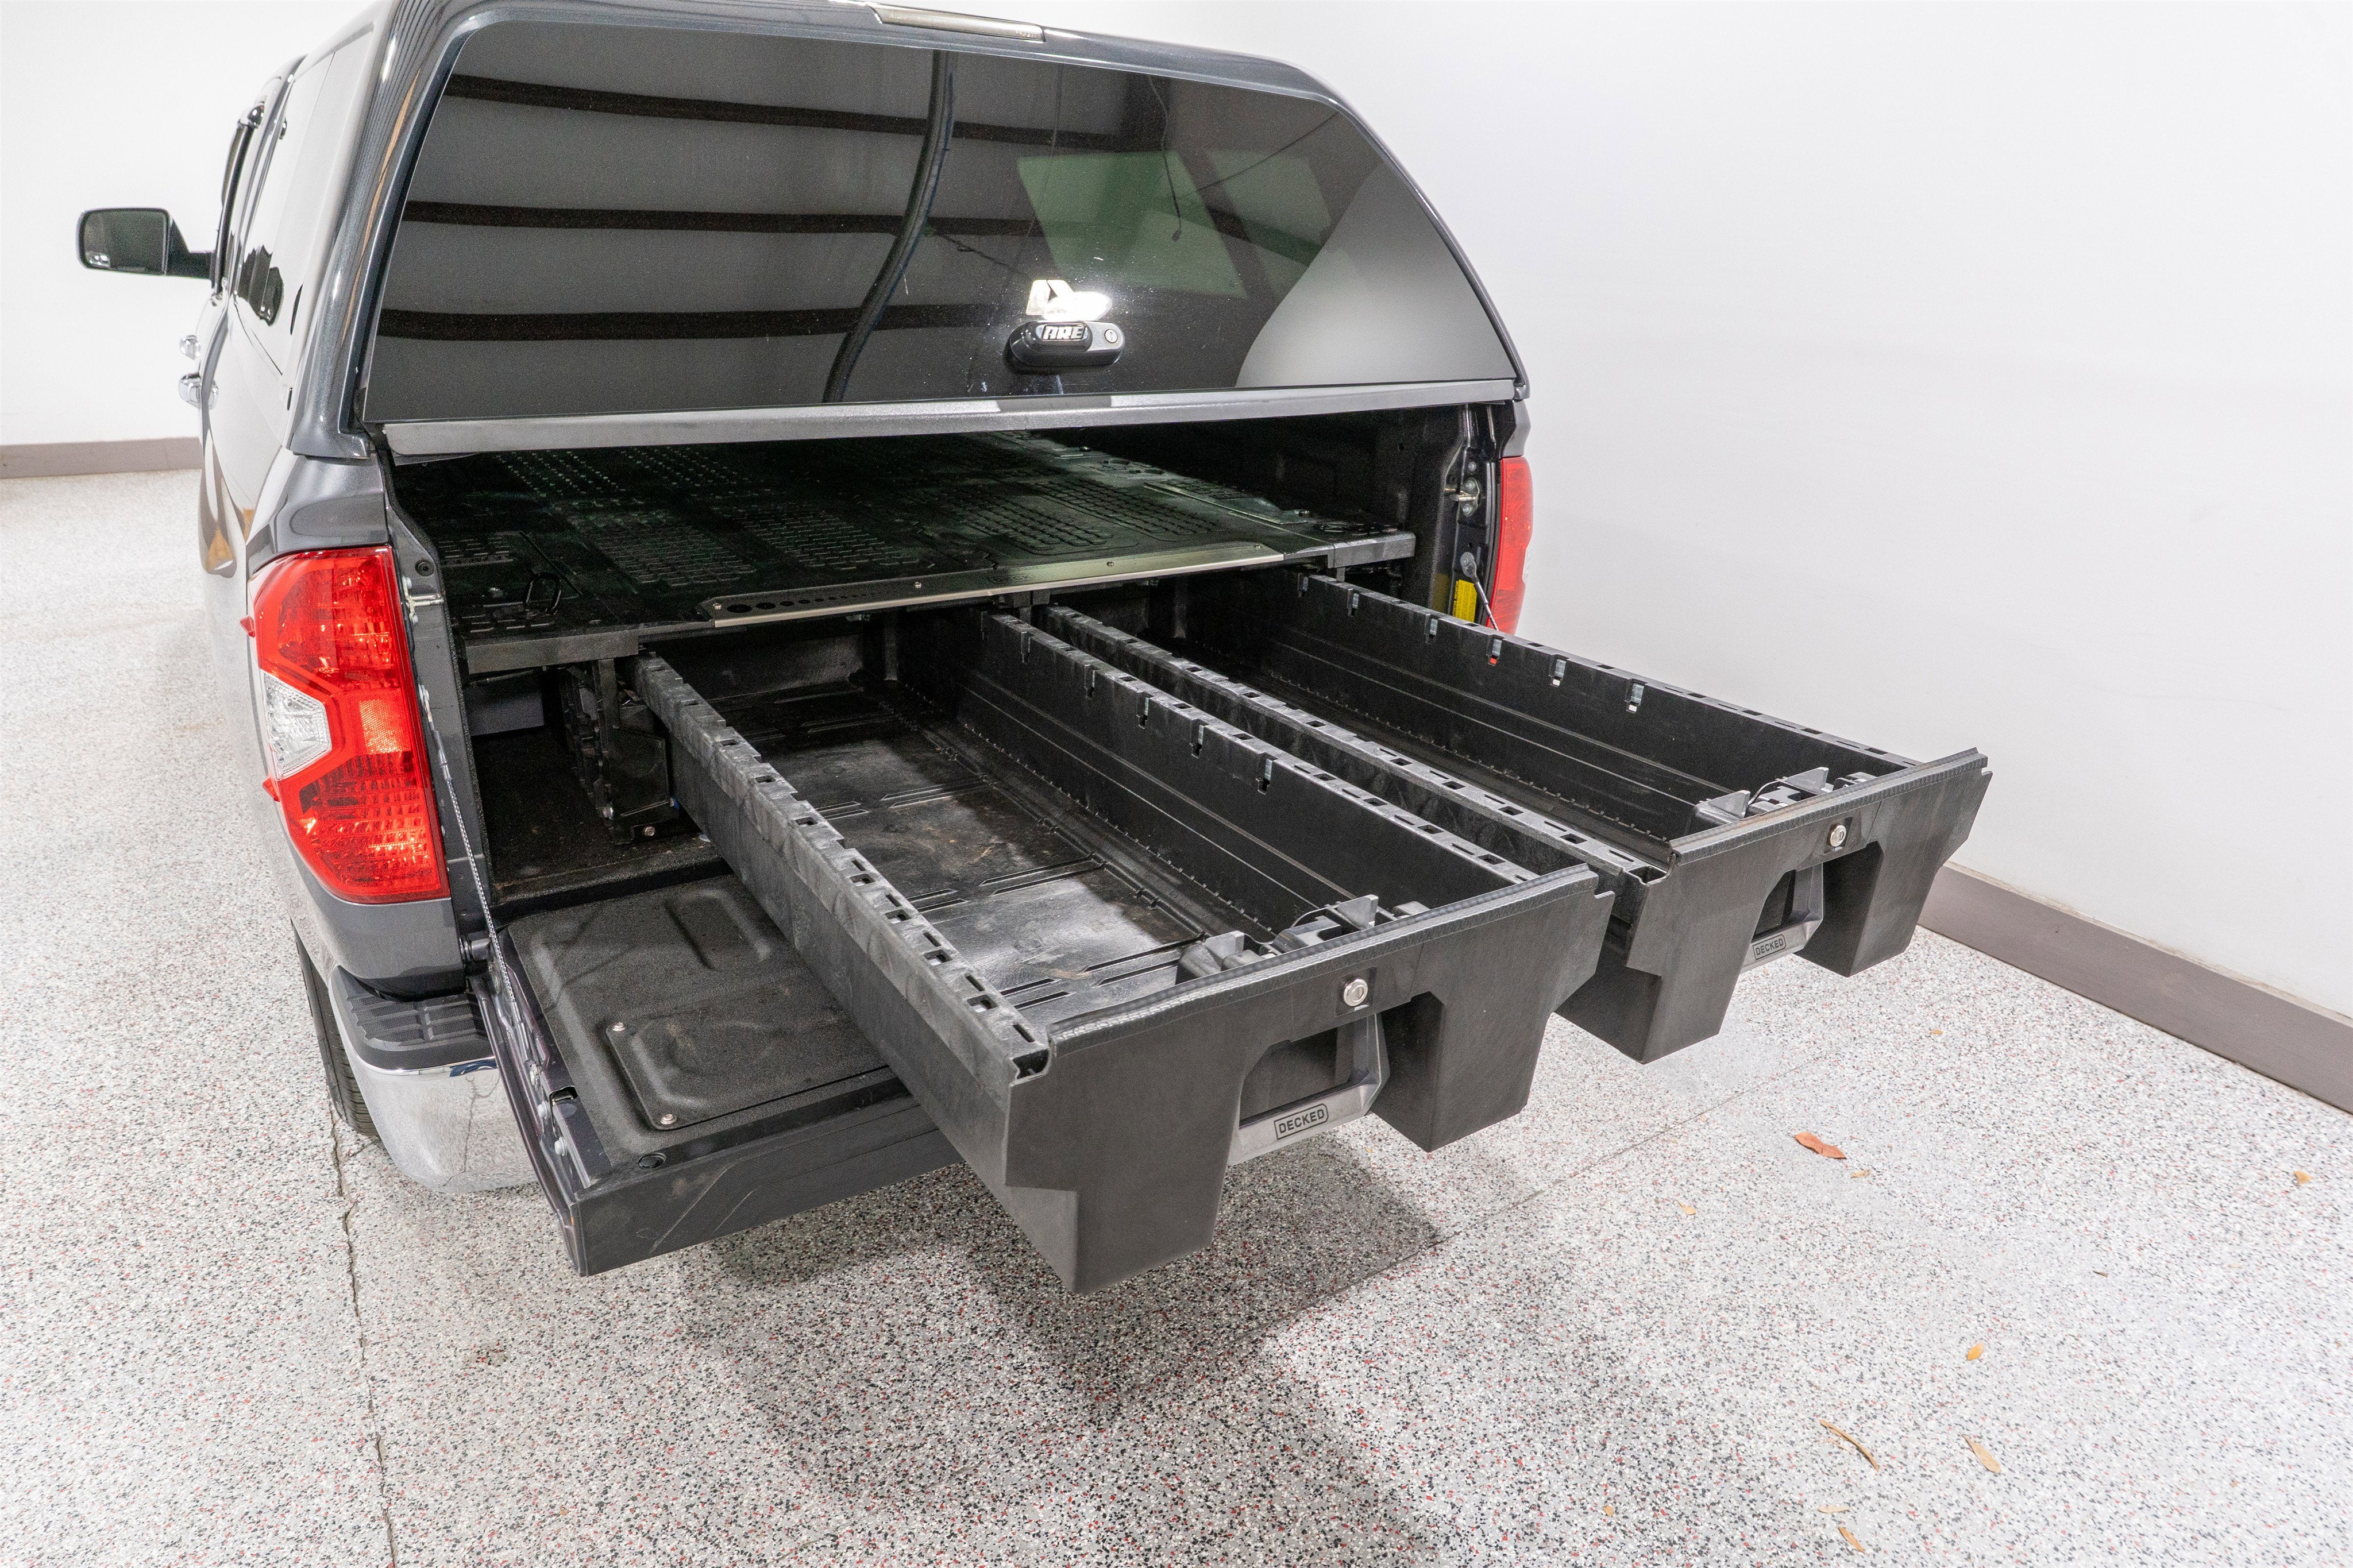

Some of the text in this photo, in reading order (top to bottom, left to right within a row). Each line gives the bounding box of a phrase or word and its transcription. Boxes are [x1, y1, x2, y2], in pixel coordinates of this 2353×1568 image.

[1043, 326, 1085, 340] ARE
[1756, 938, 1784, 956] DECKED
[1279, 1109, 1325, 1134] DECKED
